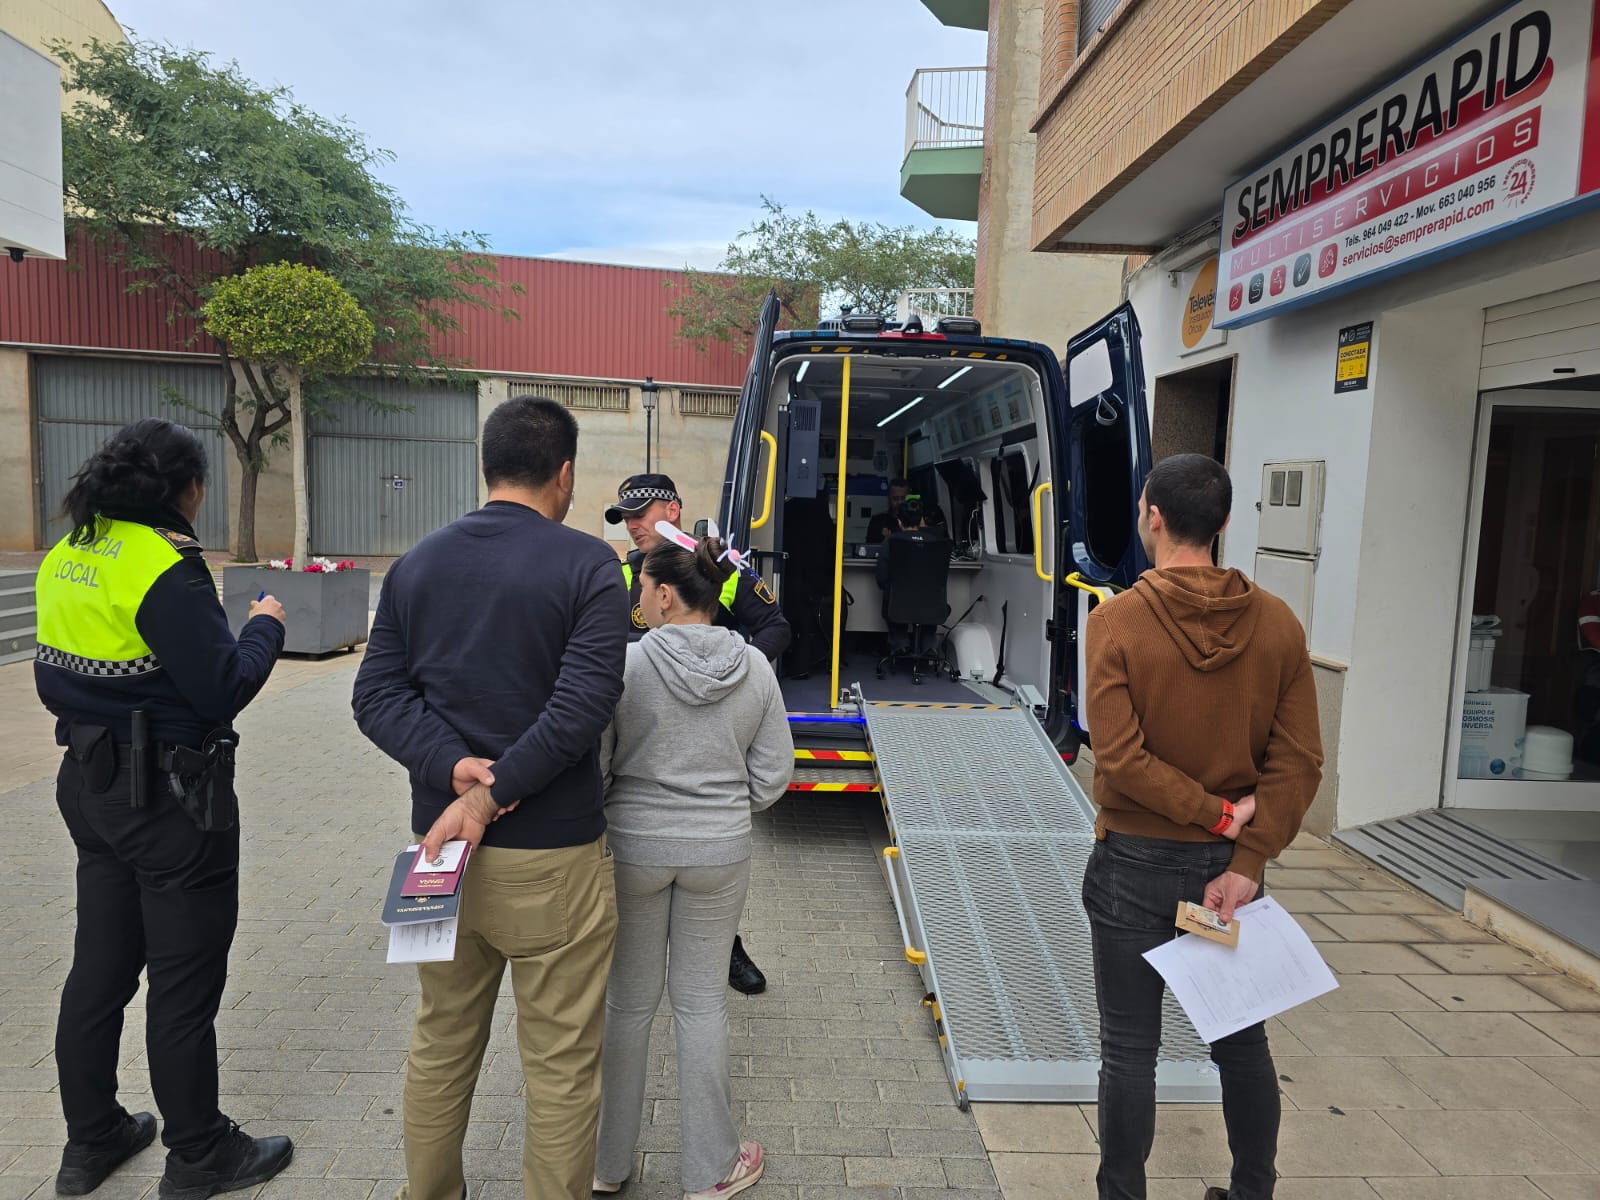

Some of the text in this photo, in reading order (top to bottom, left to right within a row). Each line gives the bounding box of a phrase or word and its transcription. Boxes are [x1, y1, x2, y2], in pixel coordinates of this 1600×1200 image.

[1235, 10, 1551, 238] SEMPRERAPID
[1233, 117, 1532, 272] MULTISERVICIOS
[1345, 234, 1361, 247] Tels.
[1363, 226, 1376, 240] 964
[1378, 219, 1392, 234] 049
[1394, 212, 1409, 227] 422
[1416, 203, 1436, 219] Mov.
[1439, 193, 1455, 210] 663
[1458, 184, 1475, 201] 040
[1477, 175, 1496, 193] 956
[1510, 170, 1527, 194] 24
[1342, 199, 1494, 266] servicios@semprerapid.com
[54, 559, 99, 588] LOCAL
[63, 531, 124, 559] ICIA
